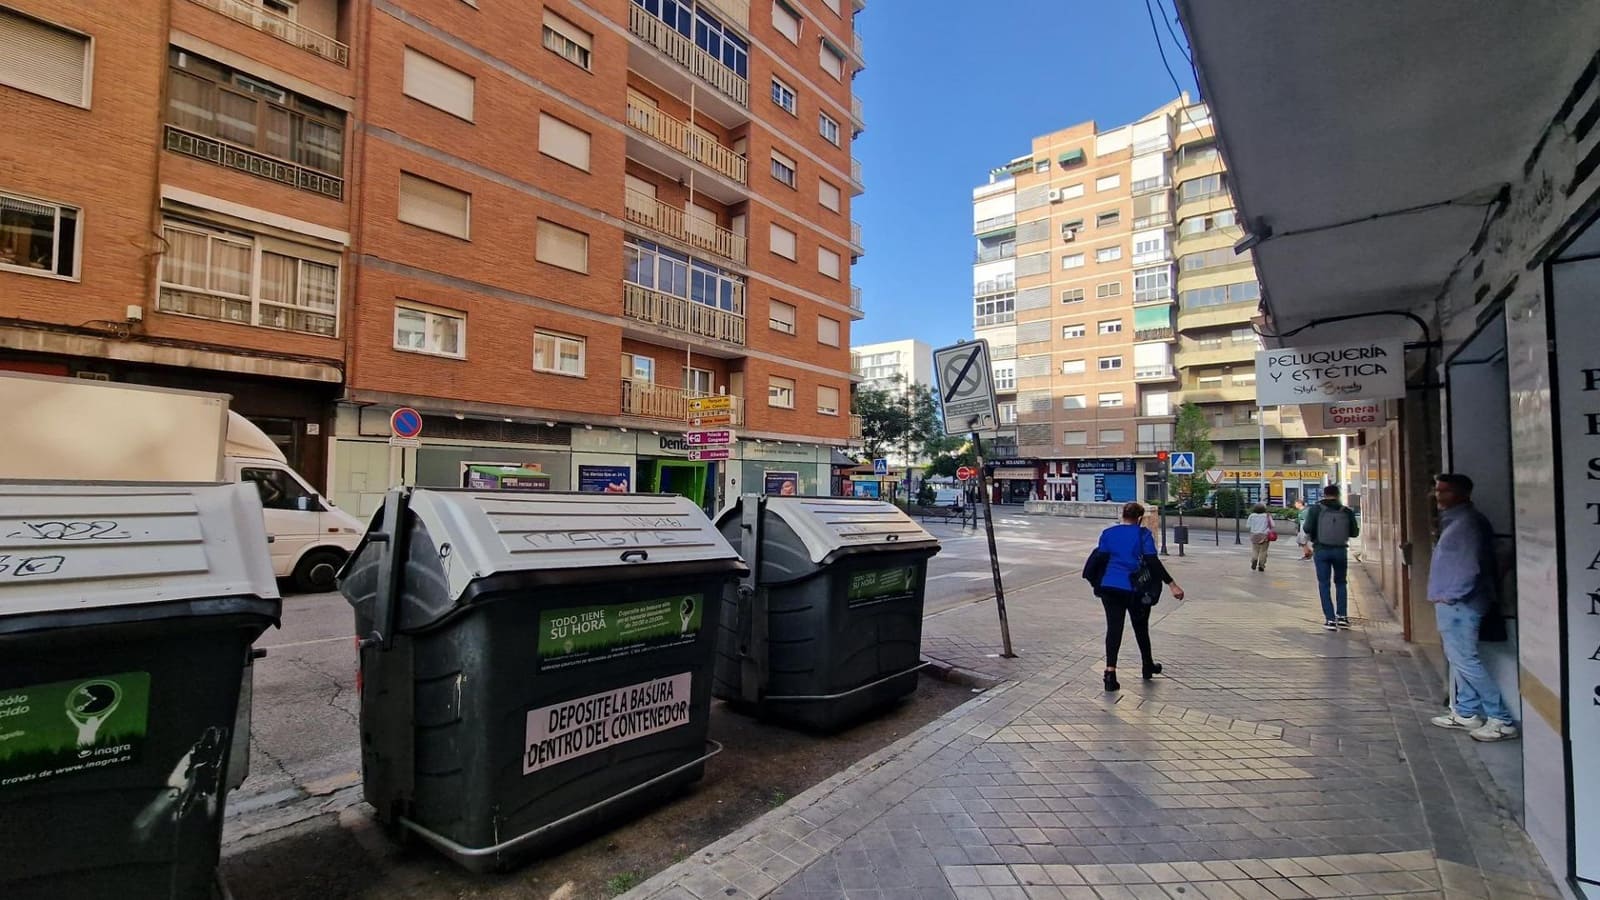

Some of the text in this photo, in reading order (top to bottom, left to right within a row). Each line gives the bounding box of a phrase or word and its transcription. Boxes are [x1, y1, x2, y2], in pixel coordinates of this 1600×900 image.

[1268, 344, 1387, 367] PELUQUERÍA
[1270, 363, 1387, 383] Y ESTÉTICA
[1329, 404, 1380, 426] General Optica
[550, 627, 567, 640] SU
[572, 618, 607, 635] HORA
[551, 610, 605, 628] TODO TIENE
[549, 681, 673, 733] DEPOSITE LA BASURA
[528, 701, 687, 767] DENTRO DEL CONTENEDOR
[94, 743, 131, 756] inagra
[2, 755, 131, 785] través de www.inagra.es
